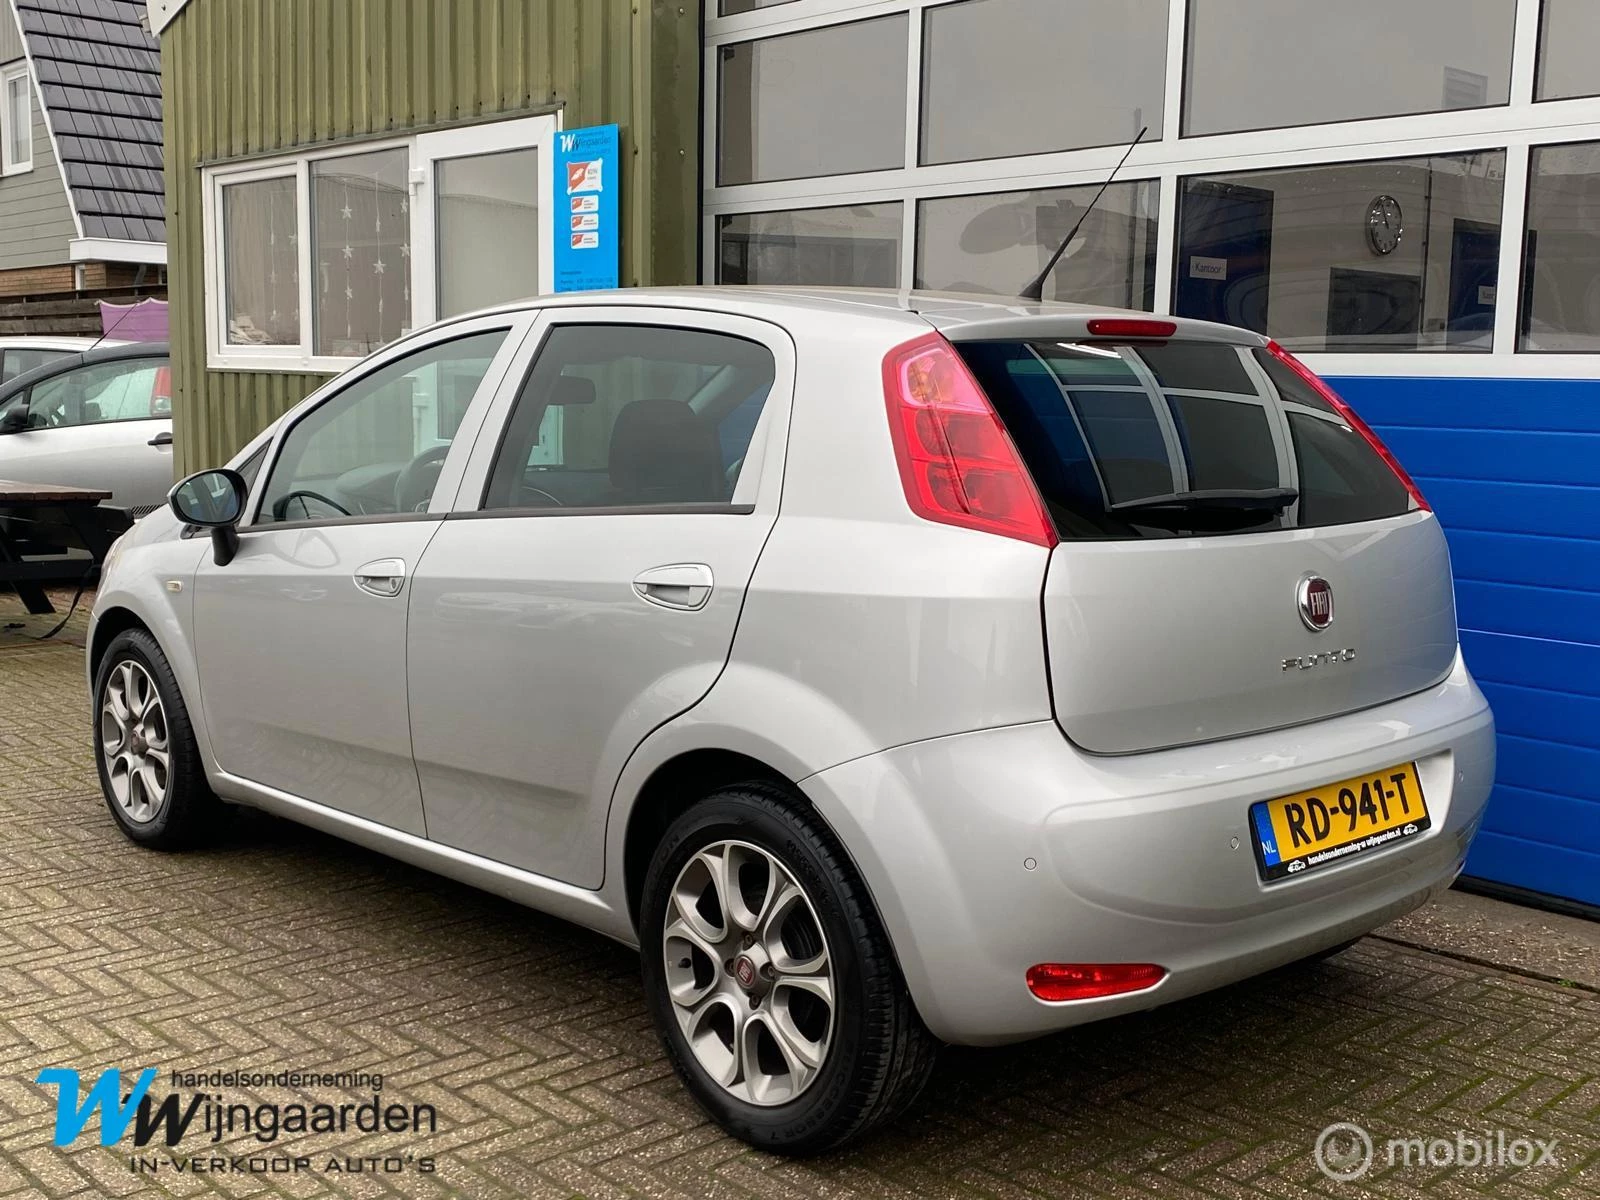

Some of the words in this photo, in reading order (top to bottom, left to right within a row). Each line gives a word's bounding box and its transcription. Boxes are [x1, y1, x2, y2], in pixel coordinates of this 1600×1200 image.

[1310, 591, 1328, 616] FIAT
[1282, 648, 1355, 672] PUNTO
[1284, 773, 1409, 848] RD-941-T
[1261, 842, 1276, 855] NL
